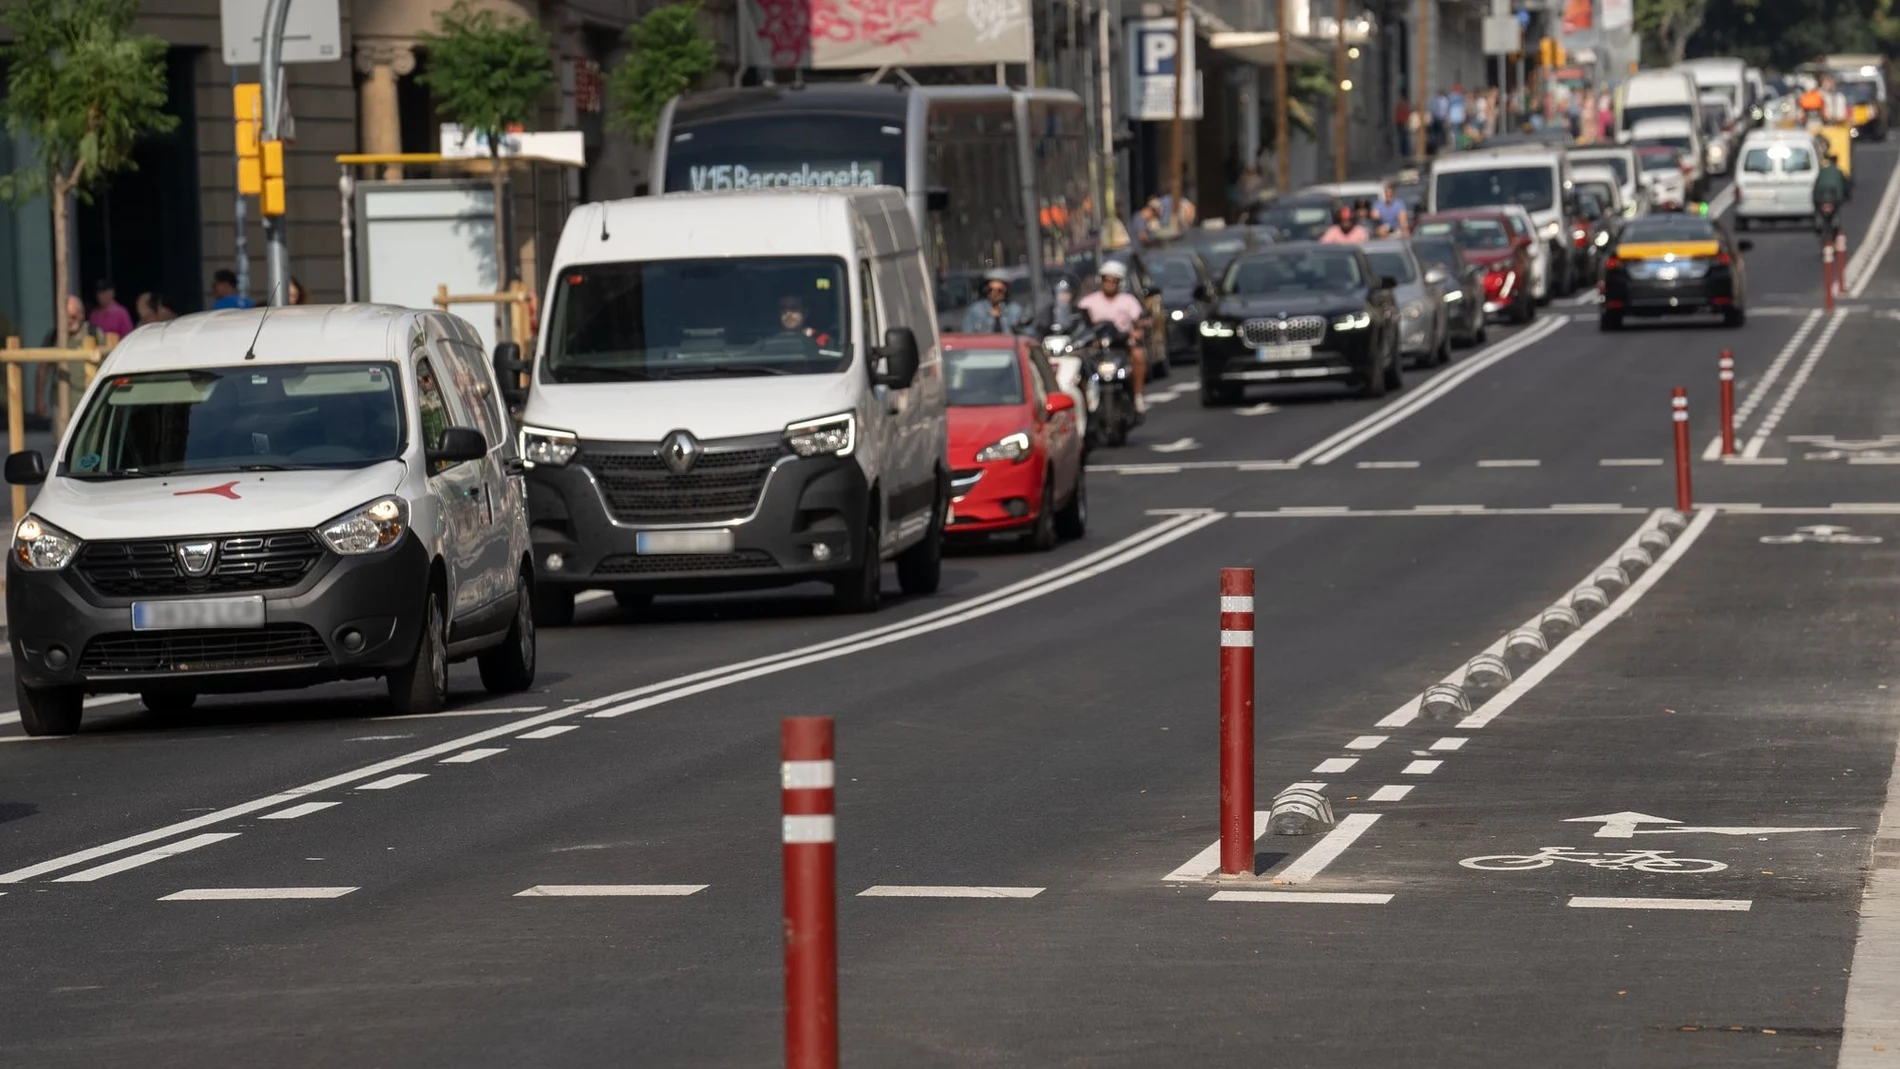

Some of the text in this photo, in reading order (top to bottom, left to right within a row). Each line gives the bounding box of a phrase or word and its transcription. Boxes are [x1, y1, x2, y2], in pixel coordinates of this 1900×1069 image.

[1144, 33, 1177, 73] P
[690, 162, 875, 191] V15 Barceloneta
